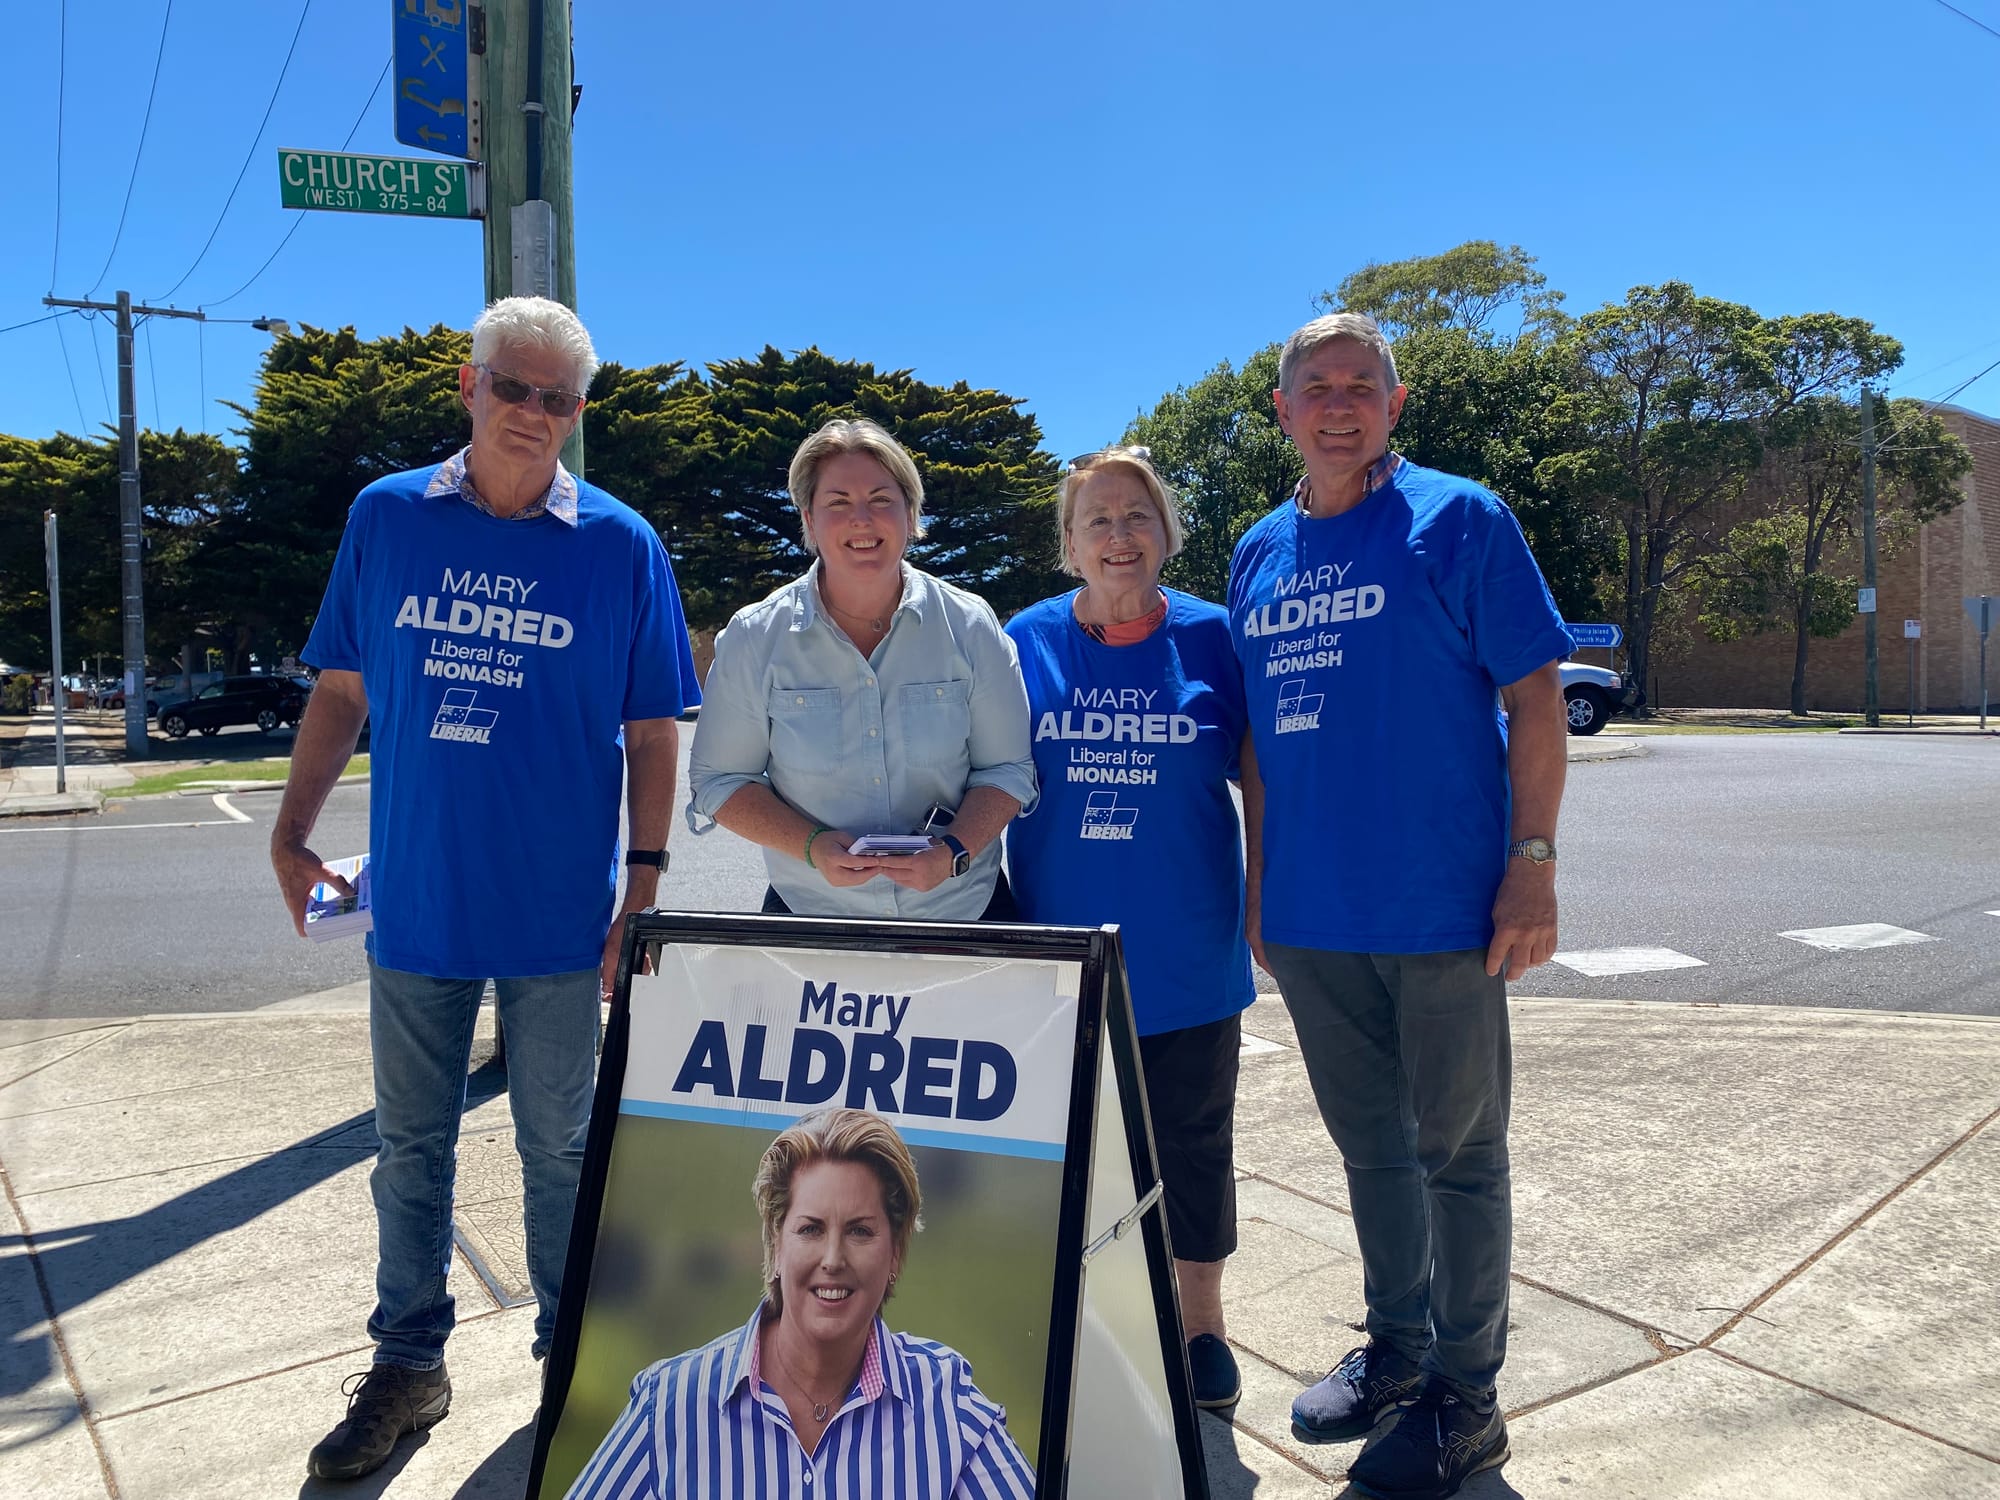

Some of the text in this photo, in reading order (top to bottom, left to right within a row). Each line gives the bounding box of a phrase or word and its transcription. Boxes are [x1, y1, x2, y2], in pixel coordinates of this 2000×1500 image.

[284, 153, 420, 194] CHURCH
[304, 187, 361, 209] (WEST)
[441, 567, 538, 604] MARY
[1273, 561, 1353, 598] MARY
[394, 595, 574, 649] ALDRED
[1243, 584, 1386, 640] ALDRED
[430, 638, 523, 668] Liberal for
[1269, 631, 1342, 658] Liberal for
[423, 658, 524, 689] MONASH
[1265, 650, 1343, 678] MONASH
[1073, 687, 1158, 710] MARY
[429, 723, 491, 745] LIBERAL
[1034, 711, 1198, 744] ALDRED
[1275, 714, 1320, 735] LIBERAL
[1070, 747, 1156, 766] Liberal for
[1067, 766, 1157, 785] MONASH
[1080, 825, 1133, 840] LIBERAL
[799, 980, 911, 1033] Mary
[671, 1019, 1018, 1122] ALDRED
